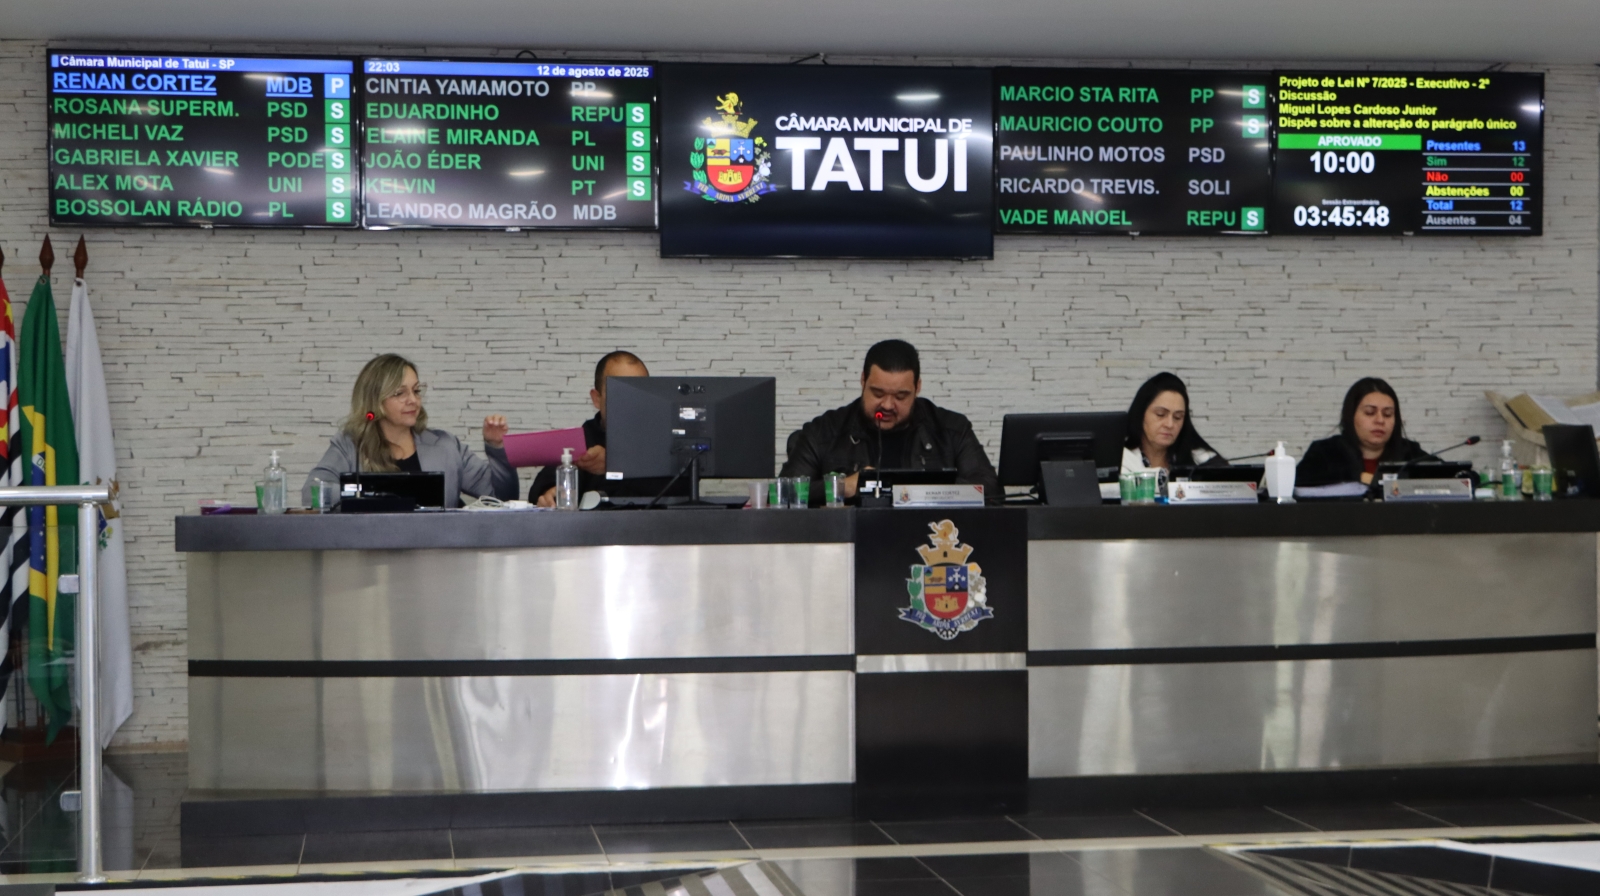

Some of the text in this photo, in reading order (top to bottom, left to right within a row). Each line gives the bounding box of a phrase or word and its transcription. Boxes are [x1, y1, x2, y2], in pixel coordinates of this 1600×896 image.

[60, 56, 104, 67] Câmara
[107, 57, 162, 70] Municipal
[165, 59, 179, 68] de
[182, 58, 210, 69] Tatuí
[219, 59, 235, 69] SP
[368, 62, 400, 73] 22:03
[537, 65, 650, 78] 12 de agosto de 2025
[53, 72, 313, 93] RENAN CORTEZ MDB
[331, 77, 344, 94] P
[365, 78, 432, 95] CINTIA
[435, 79, 550, 96] YAMAMOTO
[1279, 76, 1319, 90] Projeto
[1320, 77, 1335, 88] de
[1337, 77, 1355, 88] Lei
[1371, 77, 1408, 89] 7/2025
[1415, 77, 1470, 89] Executivo
[1000, 86, 1214, 103] MARCIO STA RITA PP
[1247, 88, 1260, 105] S
[1279, 89, 1337, 101] Discussão
[54, 98, 308, 118] ROSANA SUPERM. PSD
[330, 102, 344, 119] S
[366, 103, 624, 122] EDUARDINHO REPU
[631, 106, 645, 122] S
[1279, 103, 1438, 117] Miguel Lopes Cardoso Junior
[775, 113, 972, 133] CÂMARA MUNICIPAL DE
[1000, 116, 1214, 133] MAURICIO COUTO PP
[1247, 118, 1260, 134] S
[1278, 117, 1517, 132] Dispõe sobre a alteração do parágrafo único
[54, 123, 308, 143] MICHELI VAZ PSD
[330, 127, 344, 144] S
[367, 128, 596, 146] ELAINE MIRANDA PL
[631, 131, 645, 147] S
[1318, 136, 1382, 147] APROVADO
[1000, 146, 1226, 163] PAULINHO MOTOS PSD
[1426, 140, 1526, 152] Presentes 13
[54, 149, 324, 168] GABRIELA XAVIER PODE
[331, 152, 345, 169] S
[366, 149, 605, 171] JOÃO ÉDER UNI
[631, 156, 645, 172] S
[775, 130, 968, 193] TATUÍ
[1310, 151, 1375, 173] 10:00
[1426, 156, 1525, 168] Sim 12
[55, 174, 302, 193] ALEX MOTA UNI
[331, 177, 345, 194] S
[1426, 171, 1524, 183] Não 00
[366, 178, 596, 196] KELVIN PT
[631, 181, 646, 196] S
[1000, 178, 1231, 195] RICARDO TREVIS. SOLI
[1426, 185, 1524, 198] Abstenções 00
[56, 196, 294, 217] BOSSOLAN RÁDIO PL
[332, 202, 345, 219] S
[366, 200, 617, 220] LEANDRO MAGRÃO MDB
[1426, 199, 1524, 211] Total 12
[999, 210, 1236, 226] VADE MANOEL REPU
[1246, 210, 1259, 227] S
[1294, 205, 1390, 227] 03:45:48
[1426, 214, 1522, 226] Ausentes 04
